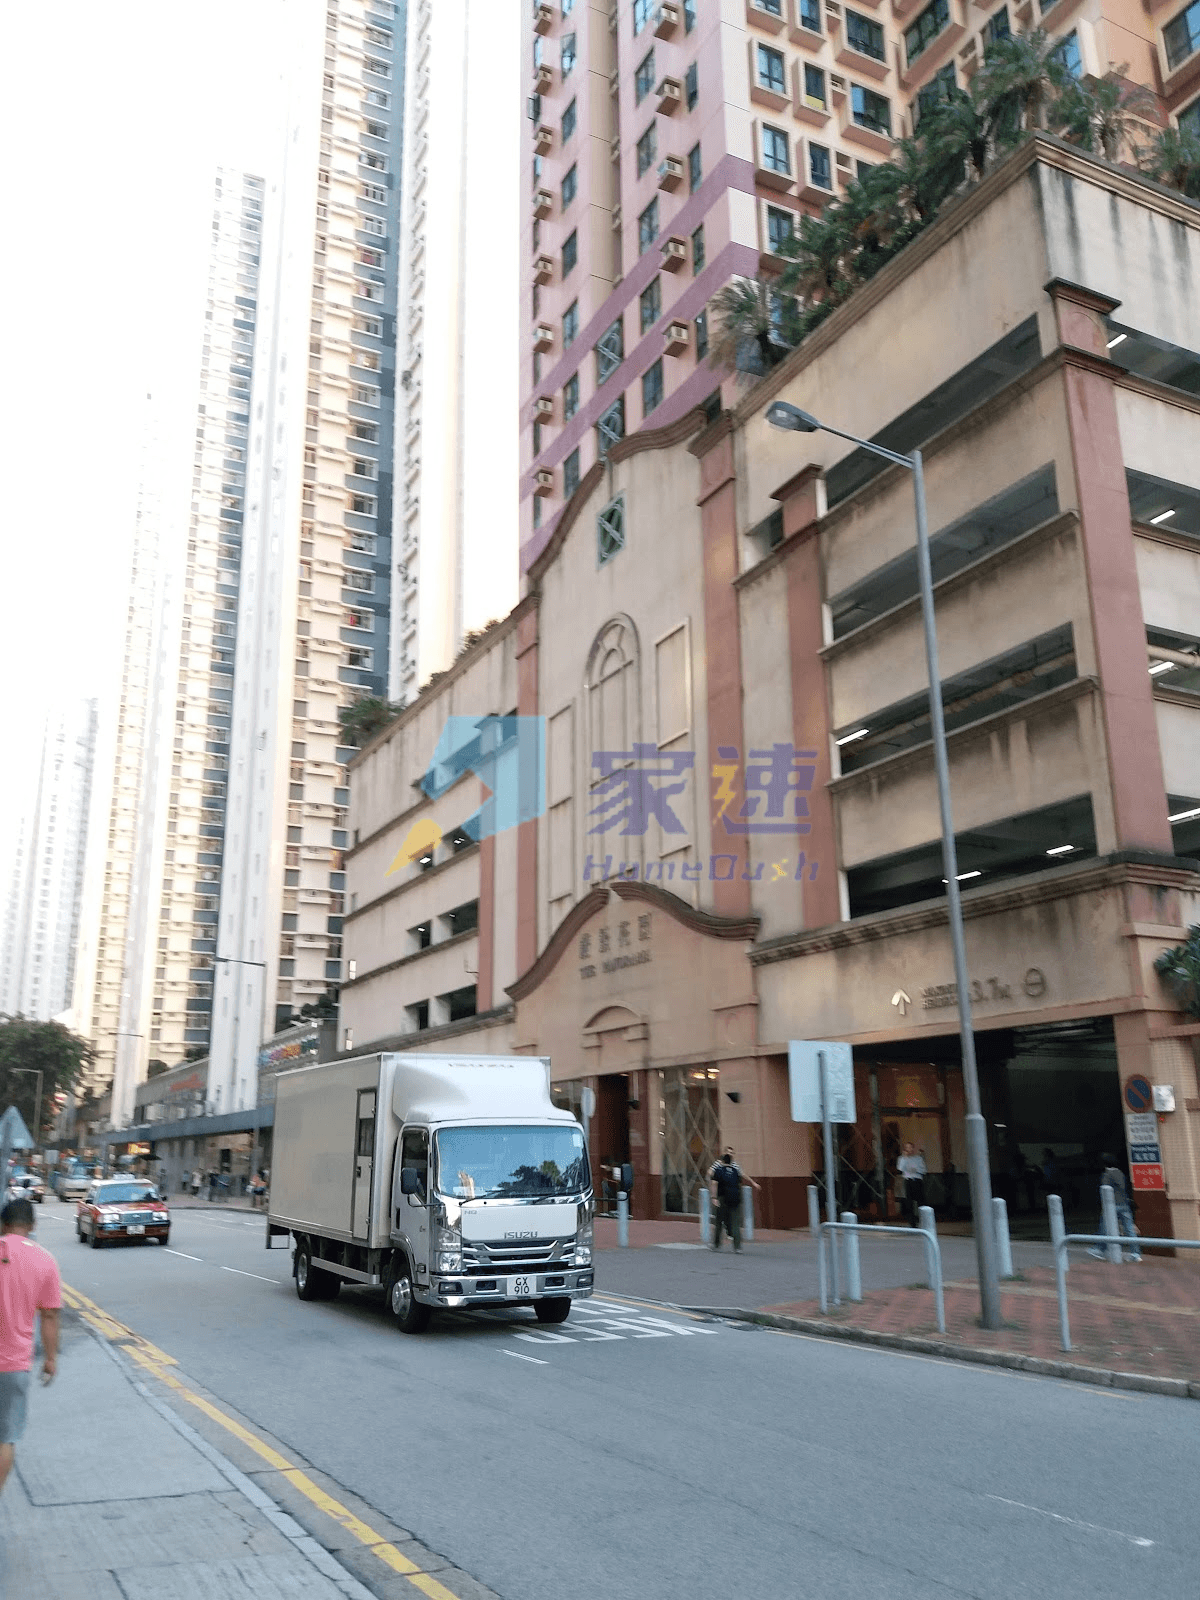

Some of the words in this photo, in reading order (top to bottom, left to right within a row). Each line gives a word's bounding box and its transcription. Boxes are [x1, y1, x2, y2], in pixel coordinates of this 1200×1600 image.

[504, 1231, 538, 1239] ISUZU
[515, 1277, 529, 1286] GX
[514, 1285, 530, 1295] 910
